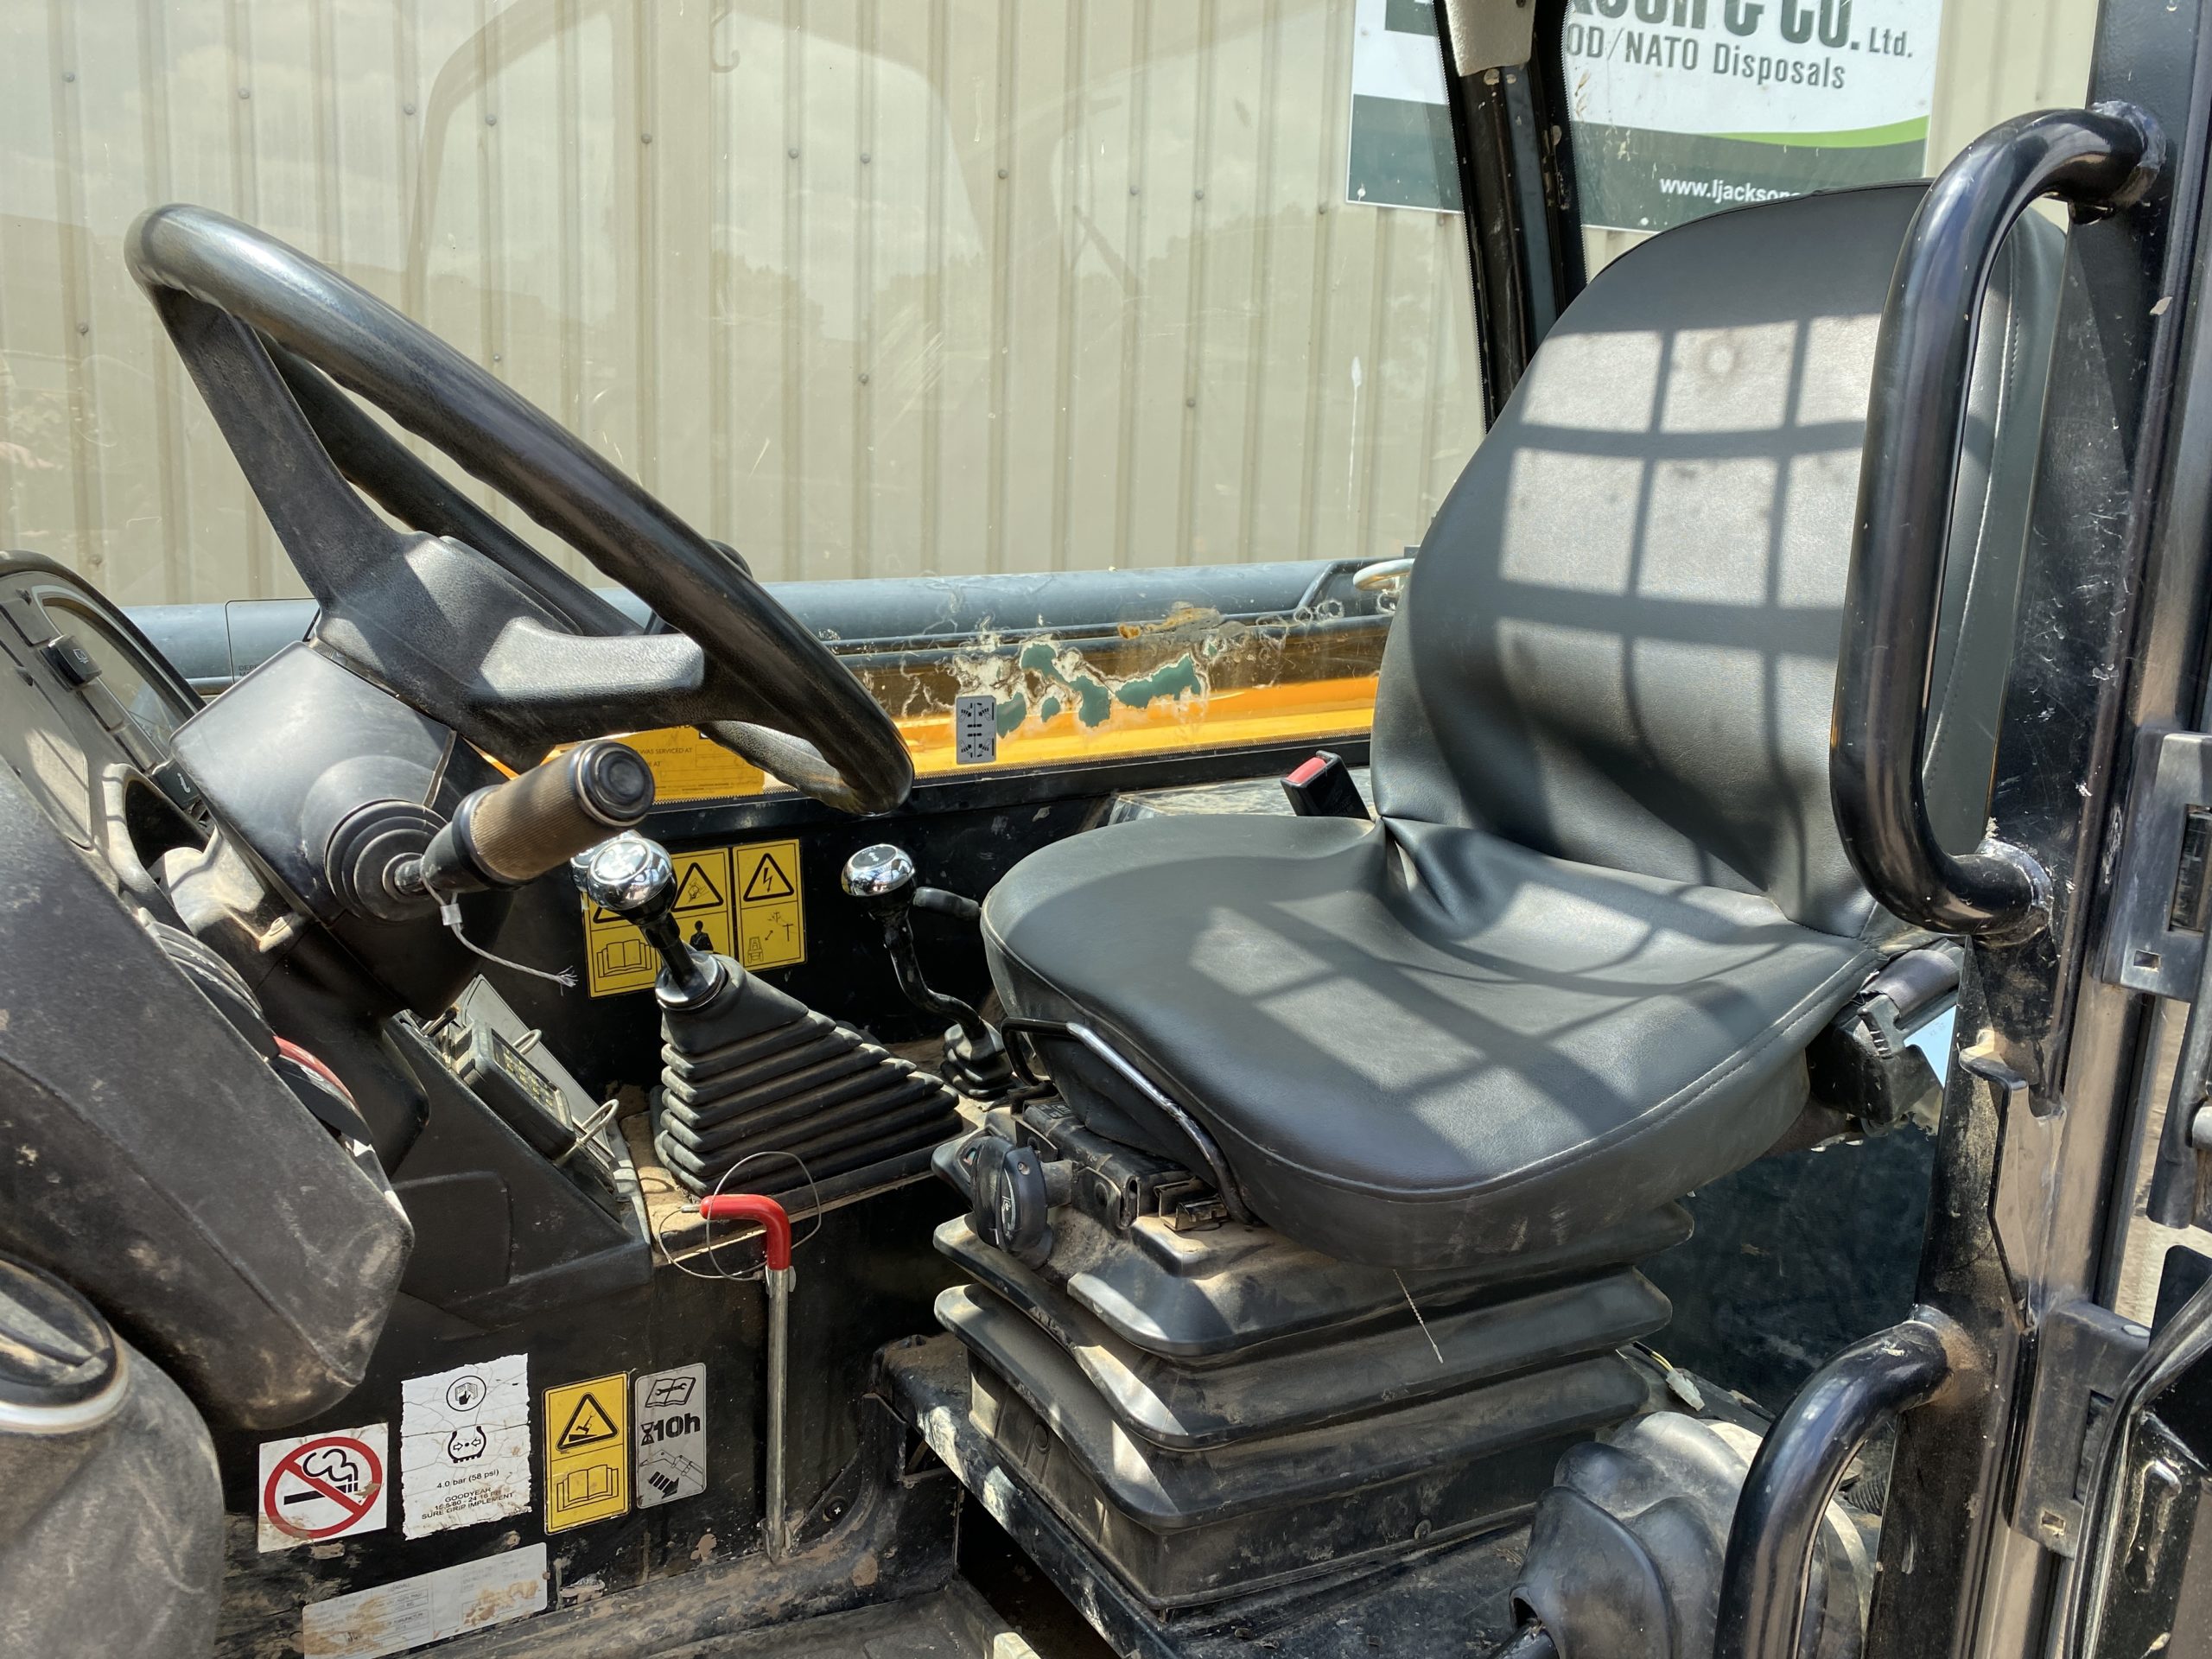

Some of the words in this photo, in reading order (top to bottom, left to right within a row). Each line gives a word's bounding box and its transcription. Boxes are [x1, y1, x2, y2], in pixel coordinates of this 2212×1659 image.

[1567, 23, 1700, 70] OD/NATO
[1713, 42, 1846, 89] Disposals
[1869, 27, 1913, 58] Ltd.
[653, 1413, 701, 1441] 10h
[468, 1472, 482, 1483] (58
[484, 1469, 499, 1478] psi)
[421, 1509, 444, 1520] SURE
[446, 1504, 467, 1513] GRIP
[467, 1491, 514, 1509] IMPLEMENT
[444, 1487, 492, 1503] GOODYEAR
